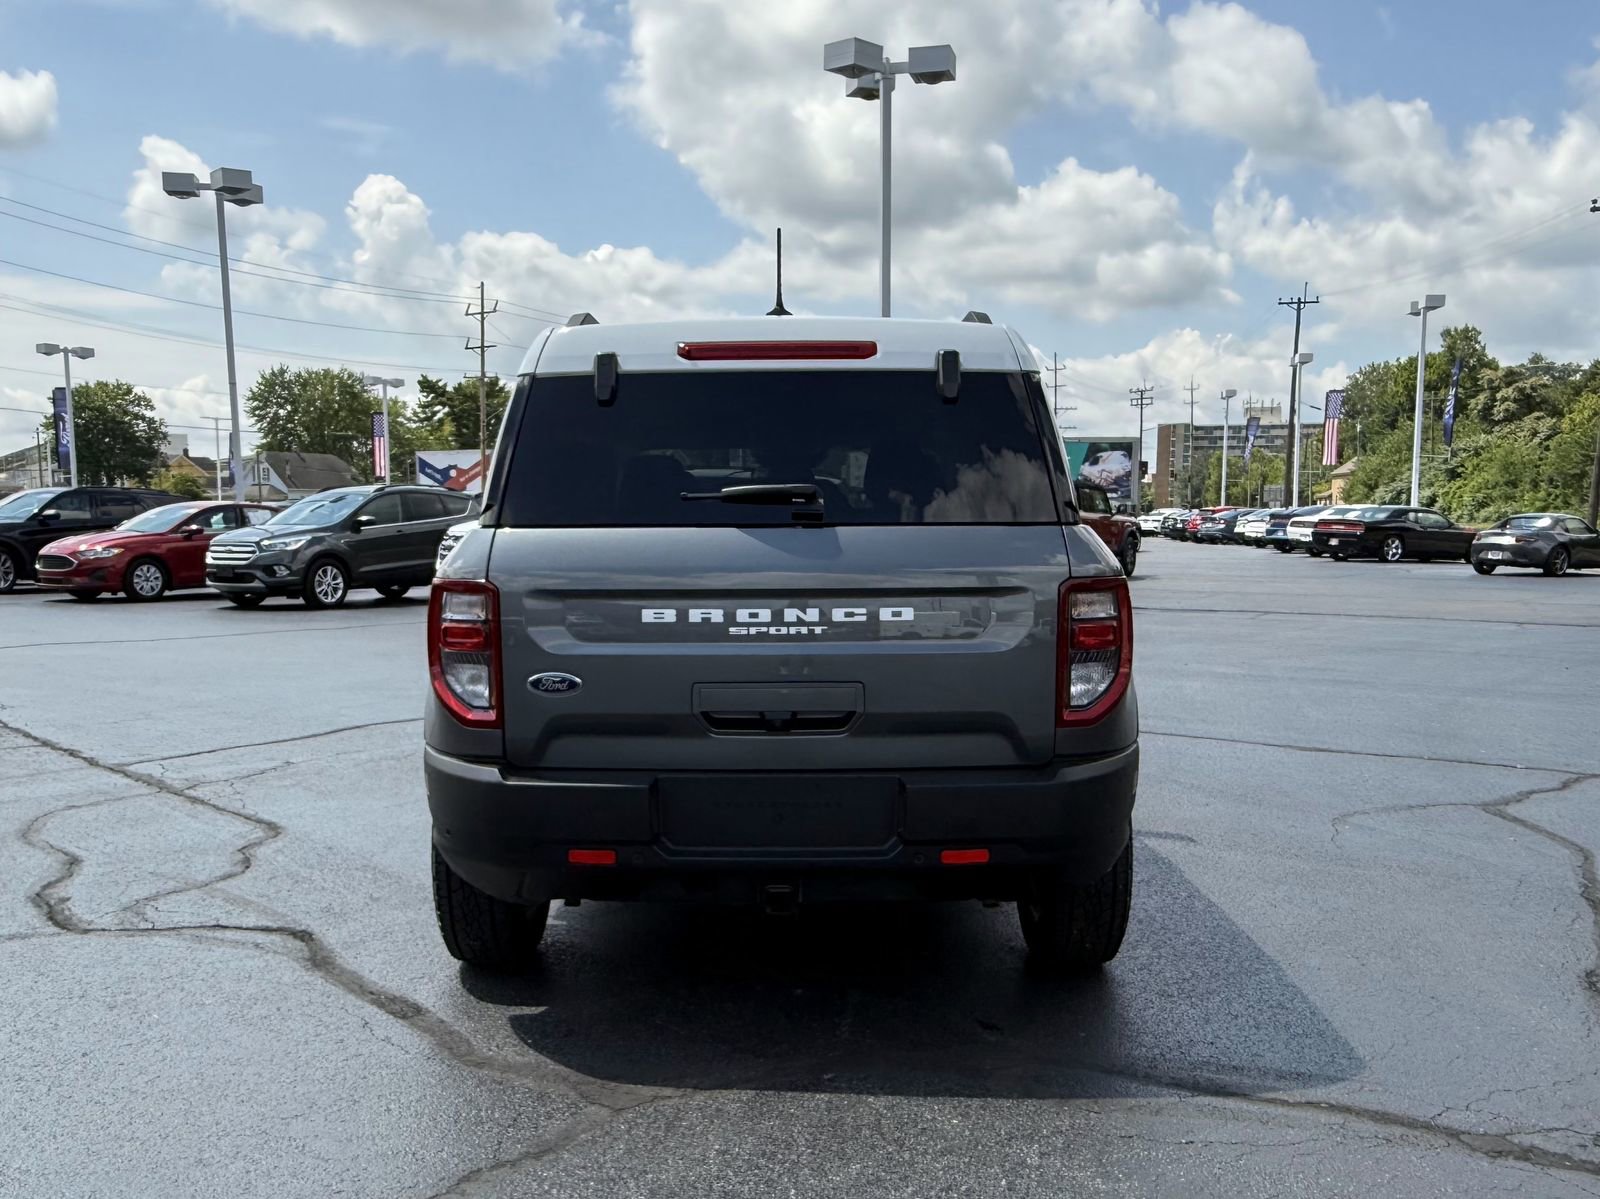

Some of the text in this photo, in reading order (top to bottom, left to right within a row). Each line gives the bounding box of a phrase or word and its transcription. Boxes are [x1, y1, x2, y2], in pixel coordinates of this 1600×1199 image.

[640, 607, 916, 623] BRONCO
[727, 626, 828, 636] SPORT
[538, 676, 570, 691] Ford
